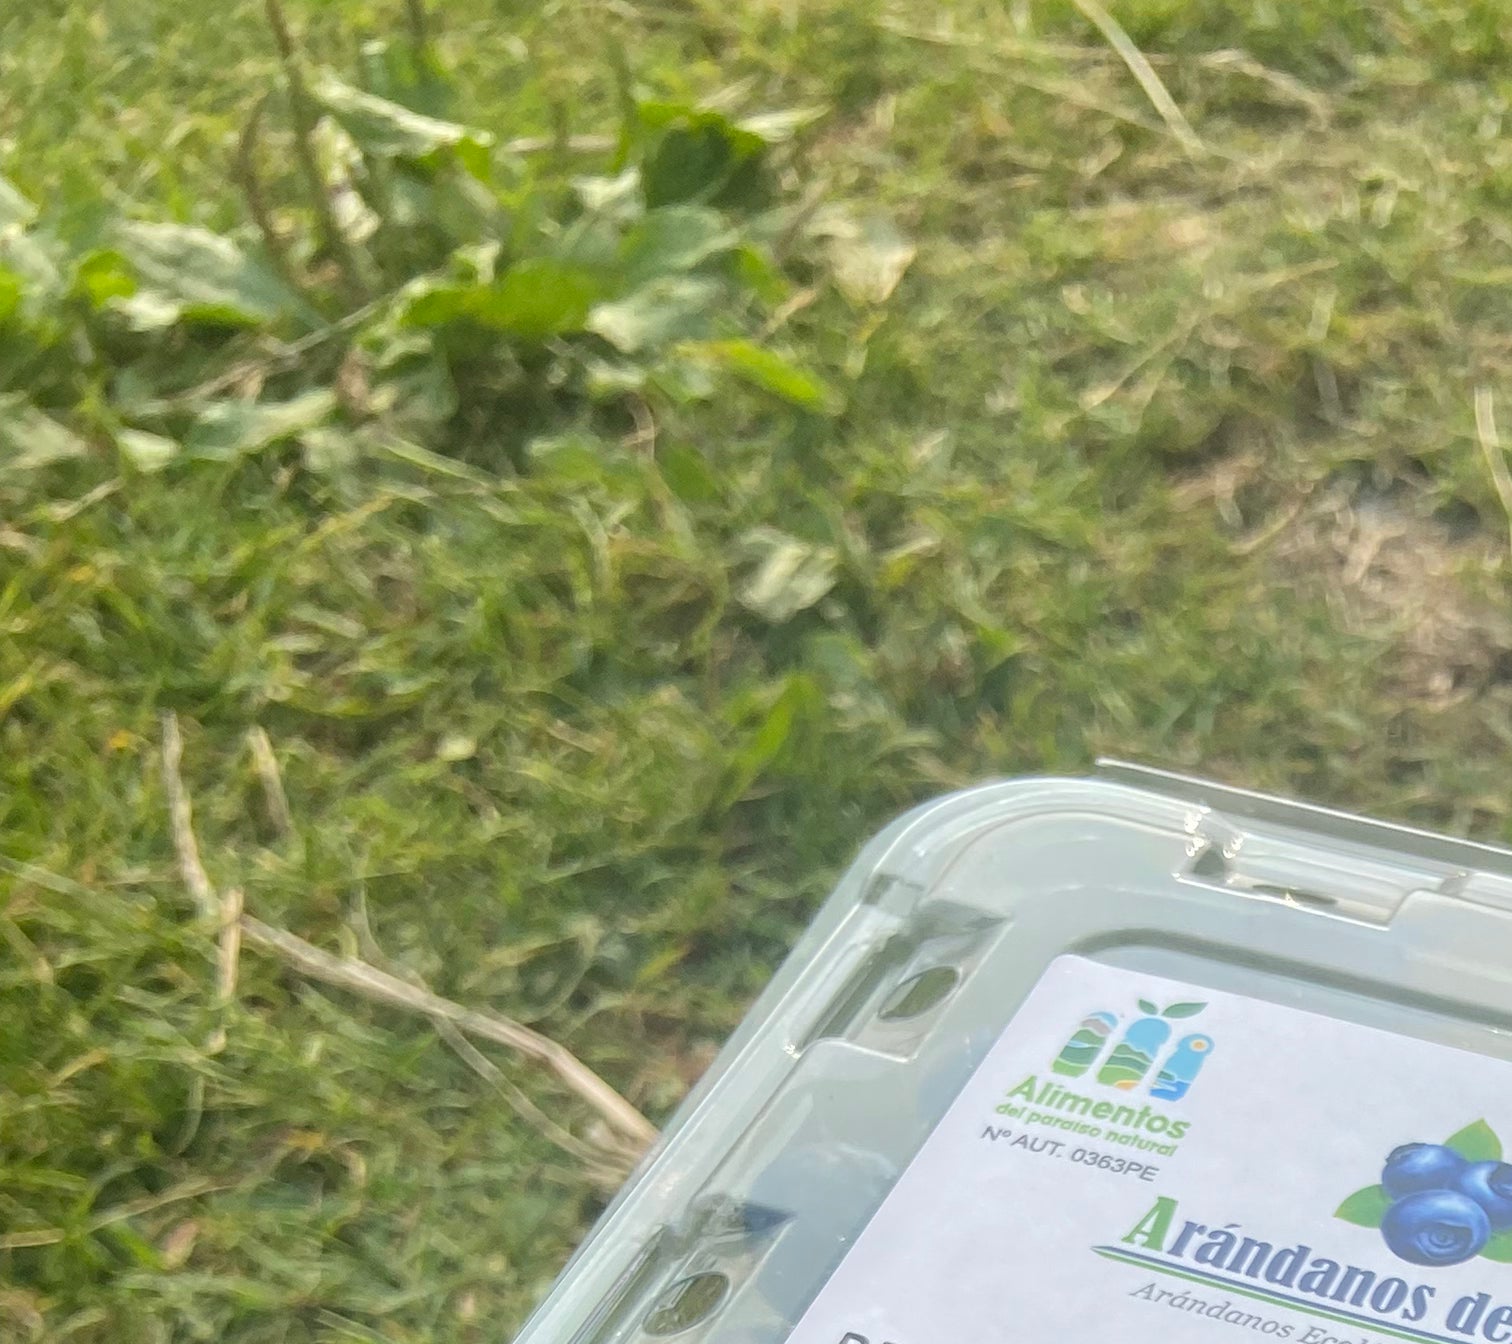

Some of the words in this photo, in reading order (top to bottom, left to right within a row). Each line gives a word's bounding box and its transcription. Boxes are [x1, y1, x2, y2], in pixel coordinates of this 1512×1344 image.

[995, 1103, 1024, 1119] del
[1105, 1131, 1178, 1157] natural
[1006, 1075, 1192, 1139] Alimentos
[1011, 1134, 1065, 1158] AUT.
[1071, 1148, 1160, 1182] 0363PE
[1121, 1195, 1436, 1322] Arándanos
[1129, 1282, 1295, 1338] Arándanos
